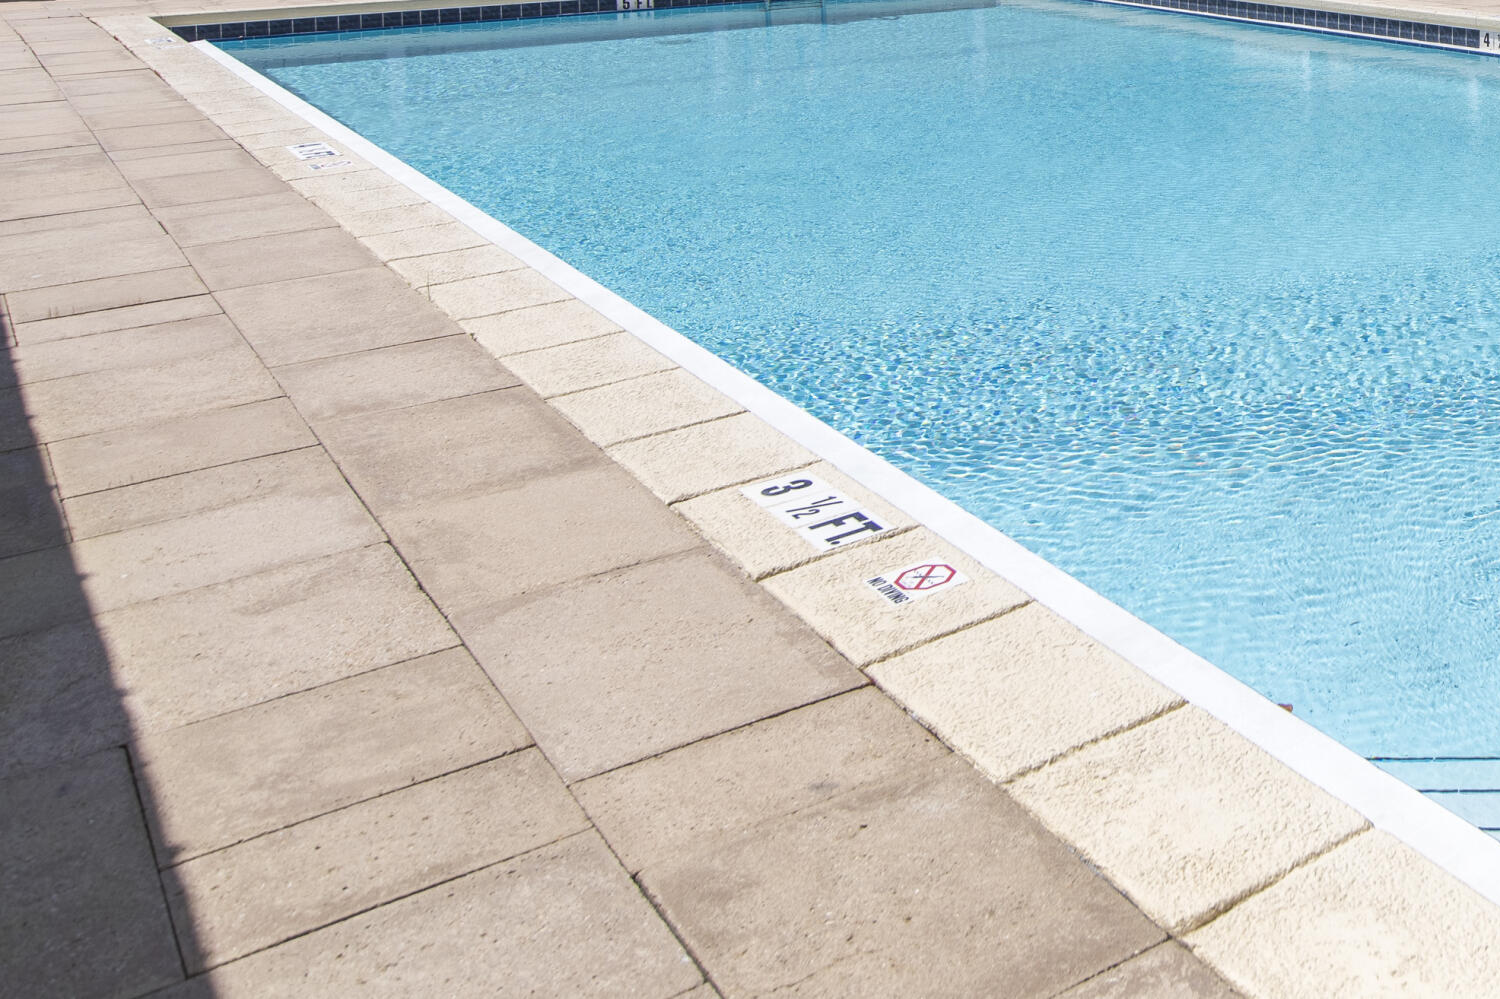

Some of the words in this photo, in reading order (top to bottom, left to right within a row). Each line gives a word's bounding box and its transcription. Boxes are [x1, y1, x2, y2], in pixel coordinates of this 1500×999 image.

[1483, 32, 1490, 47] 4
[760, 479, 813, 496] 3
[808, 511, 884, 545] FT.
[866, 576, 887, 587] NO
[876, 584, 910, 604] DIVING
